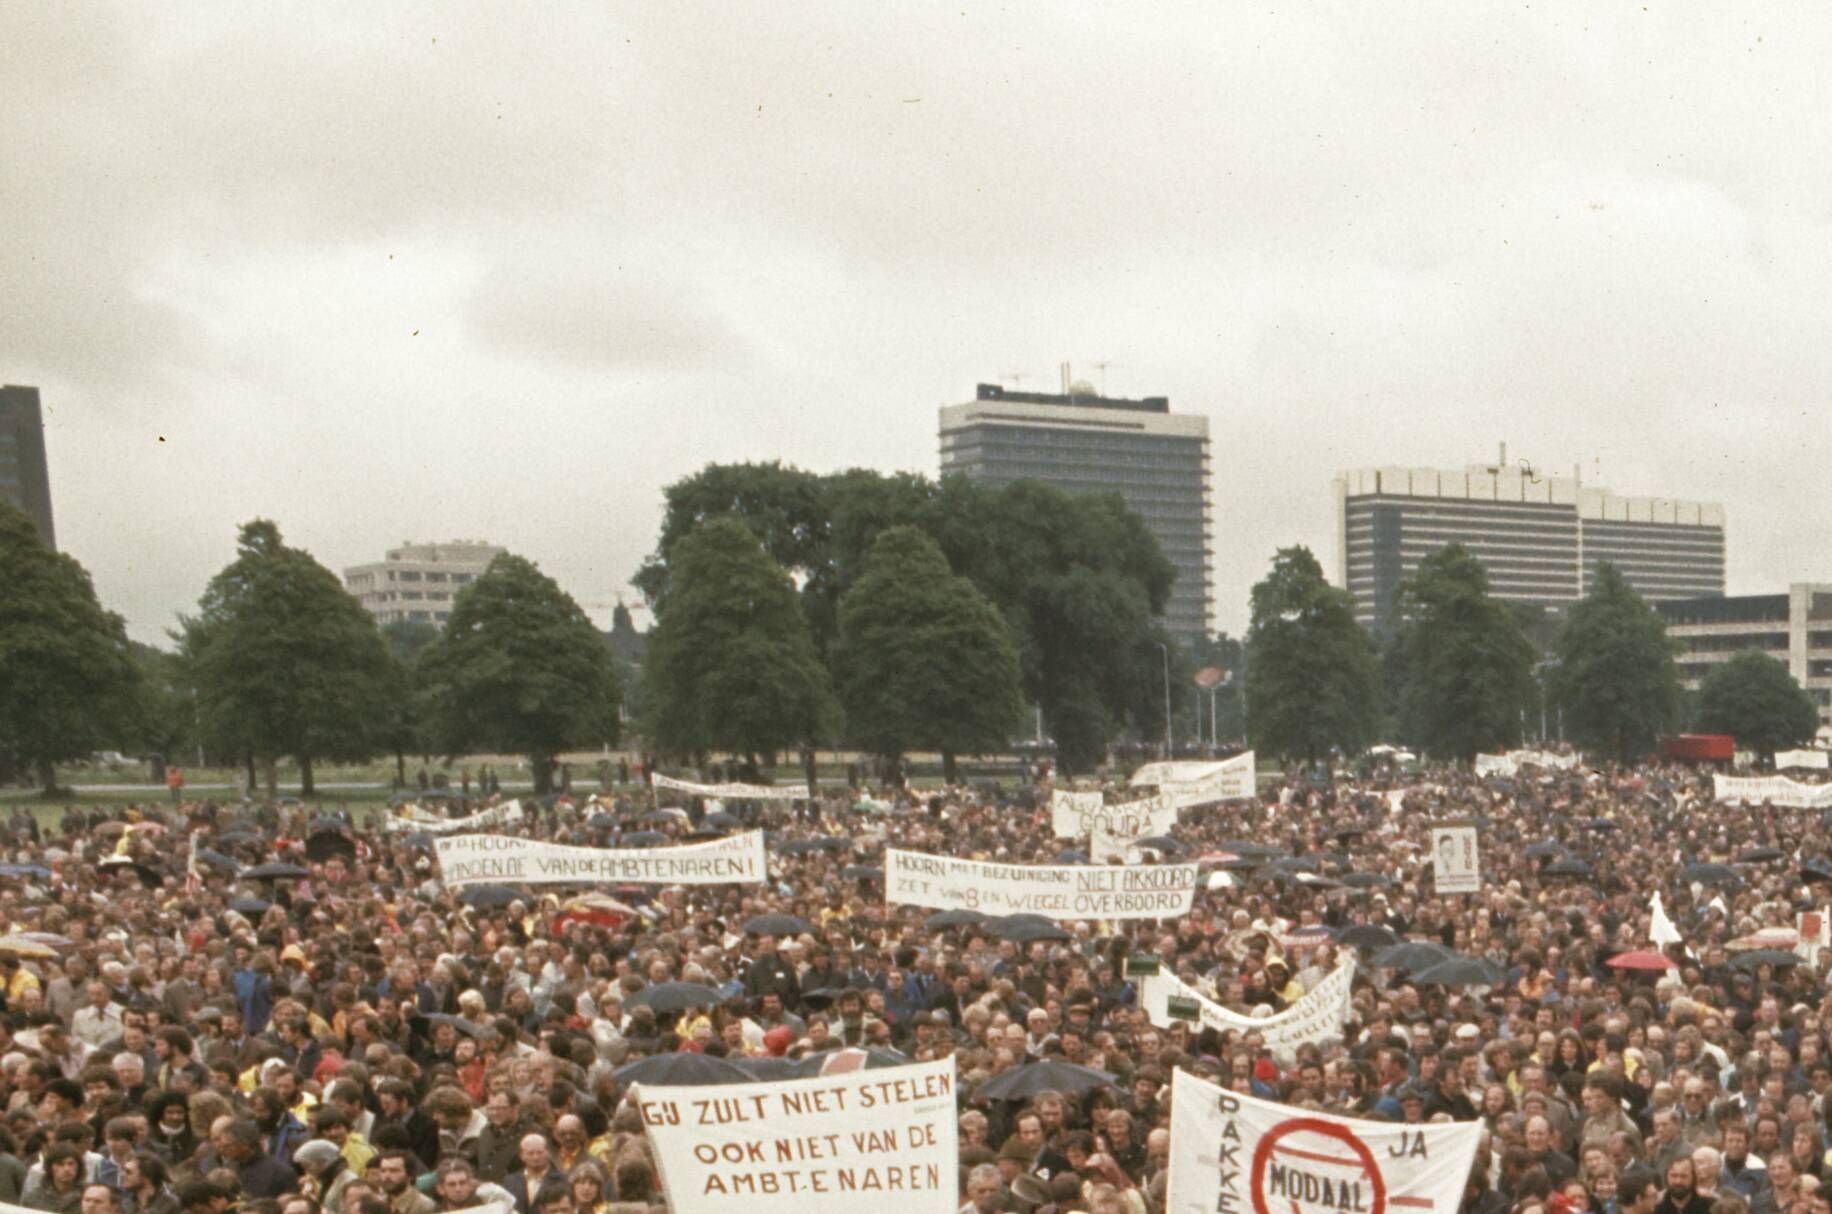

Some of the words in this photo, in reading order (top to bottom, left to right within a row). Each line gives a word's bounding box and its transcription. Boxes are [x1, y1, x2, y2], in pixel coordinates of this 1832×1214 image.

[896, 851, 945, 878] HOORN
[1077, 870, 1119, 891] NIET
[1123, 867, 1195, 890] AKKOORD
[1005, 891, 1070, 911] WIEGEL
[692, 1094, 768, 1126] ZULT
[781, 1087, 848, 1117] NIET
[859, 1072, 951, 1109] STELEN
[693, 1140, 766, 1165] OOK
[774, 1134, 840, 1164] NIET
[851, 1127, 898, 1154] VAN
[908, 1123, 937, 1150] DE
[1387, 1130, 1428, 1159] JA
[703, 1163, 940, 1196] AMBTENAREN
[1269, 1161, 1368, 1214] MODAAL
